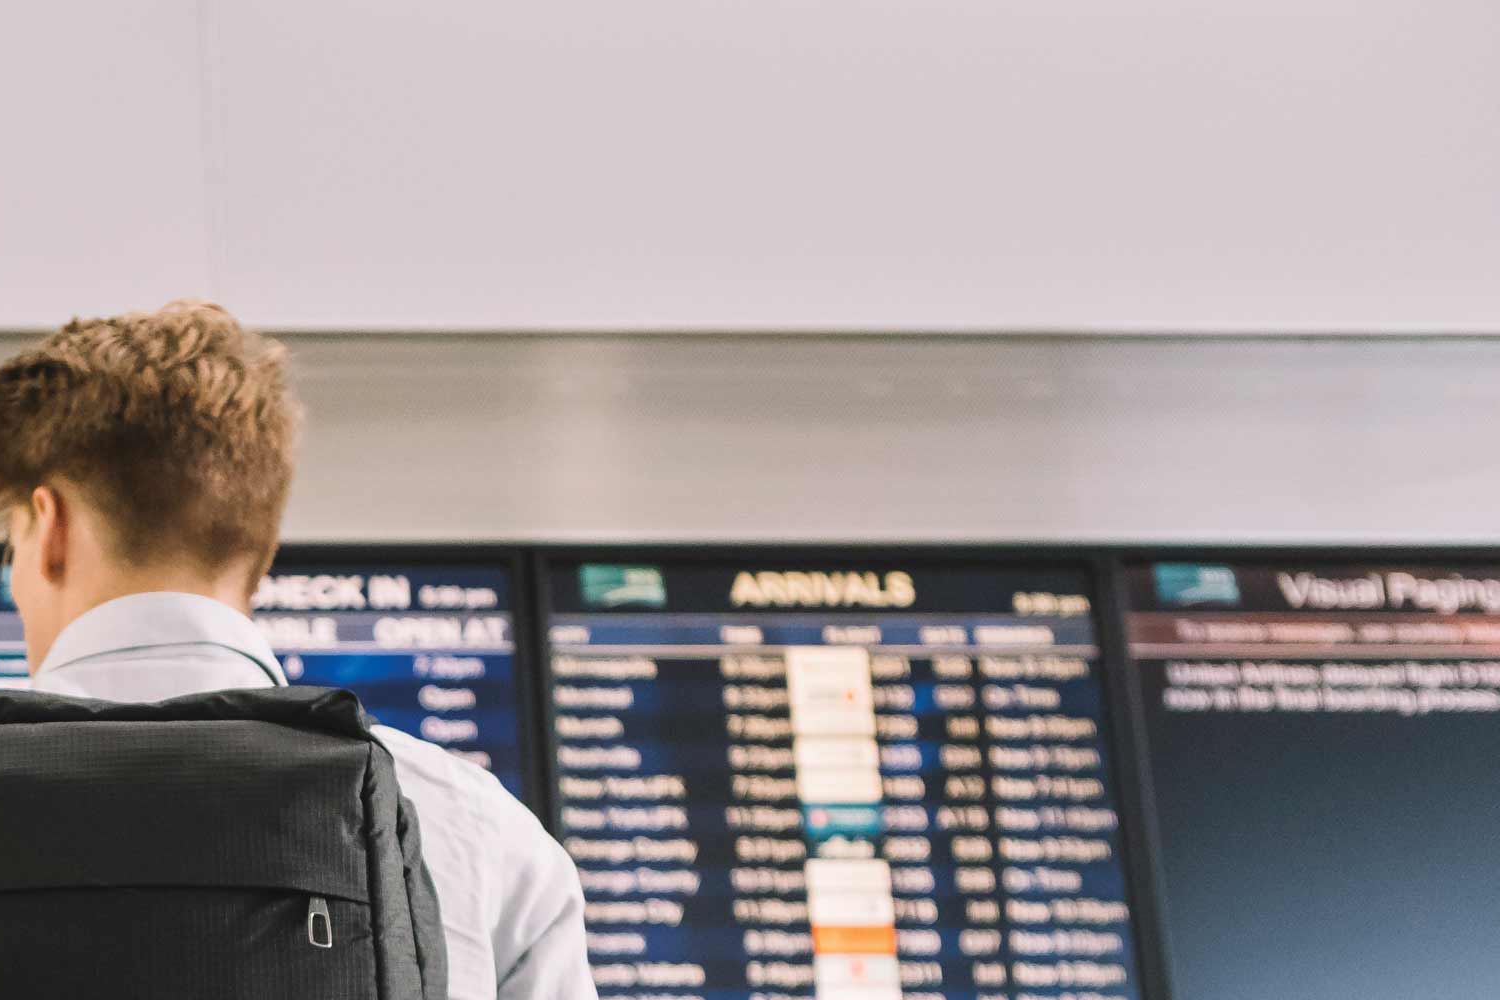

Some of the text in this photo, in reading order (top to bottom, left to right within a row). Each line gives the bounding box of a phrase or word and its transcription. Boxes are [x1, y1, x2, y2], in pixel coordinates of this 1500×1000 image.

[252, 575, 411, 609] HECK IN
[731, 572, 915, 605] ARRIVALS
[1277, 572, 1385, 609] Visual
